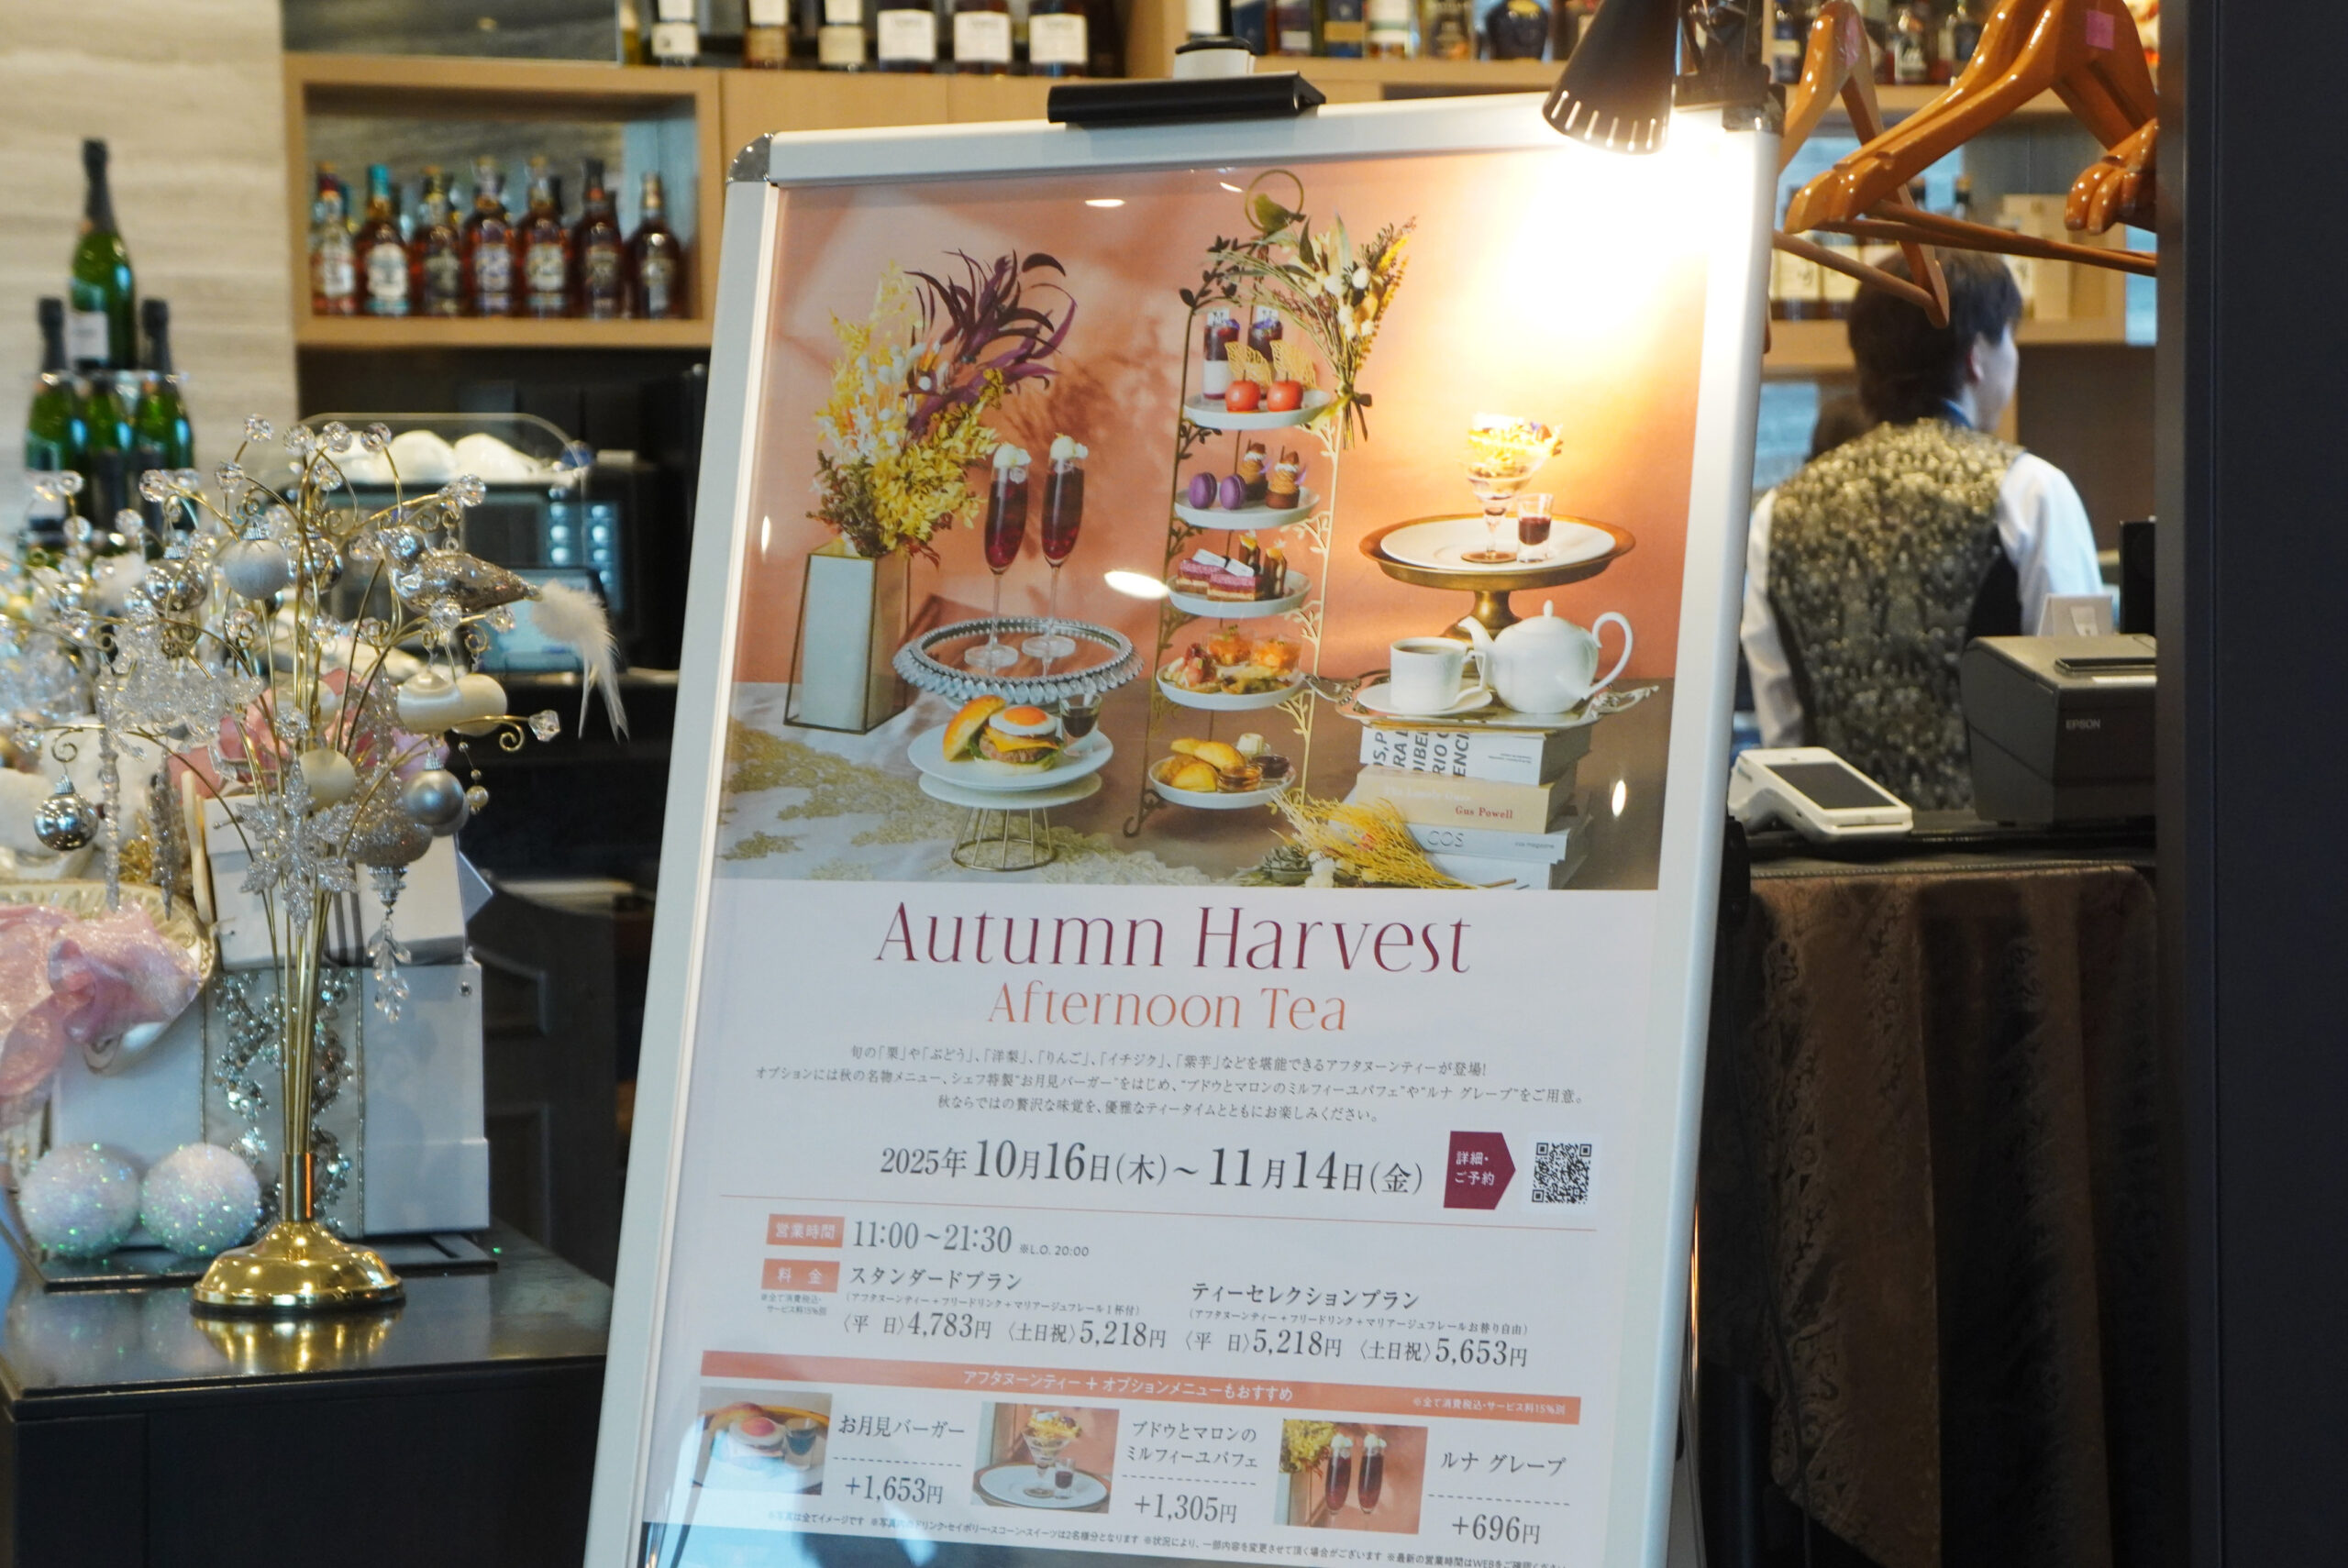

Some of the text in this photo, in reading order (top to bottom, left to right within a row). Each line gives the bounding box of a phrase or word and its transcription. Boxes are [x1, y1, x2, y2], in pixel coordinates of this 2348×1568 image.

[2066, 719, 2100, 730] EPSON
[1455, 805, 1513, 819] Gus Powell
[1427, 830, 1465, 847] COS
[874, 901, 1472, 974] Autumn Harvest
[988, 979, 1346, 1031] Afternoon Tea
[1454, 1172, 1495, 1187] ご予約
[776, 1221, 836, 1240] 営業時間
[1055, 1244, 1090, 1257] 20:00
[849, 1265, 1023, 1291] スタンダードプラン
[1191, 1282, 1419, 1310] ティーセレクションプラン
[837, 1414, 965, 1439] お月見バーガー
[1132, 1420, 1257, 1443] ブドウとマロンの
[1126, 1445, 1258, 1468] ミルフィーユパフェ
[1440, 1452, 1567, 1477] ルナ グレープ
[845, 1474, 944, 1505] +1,653円
[1135, 1493, 1237, 1524] +1,305円
[1452, 1513, 1541, 1545] +696円
